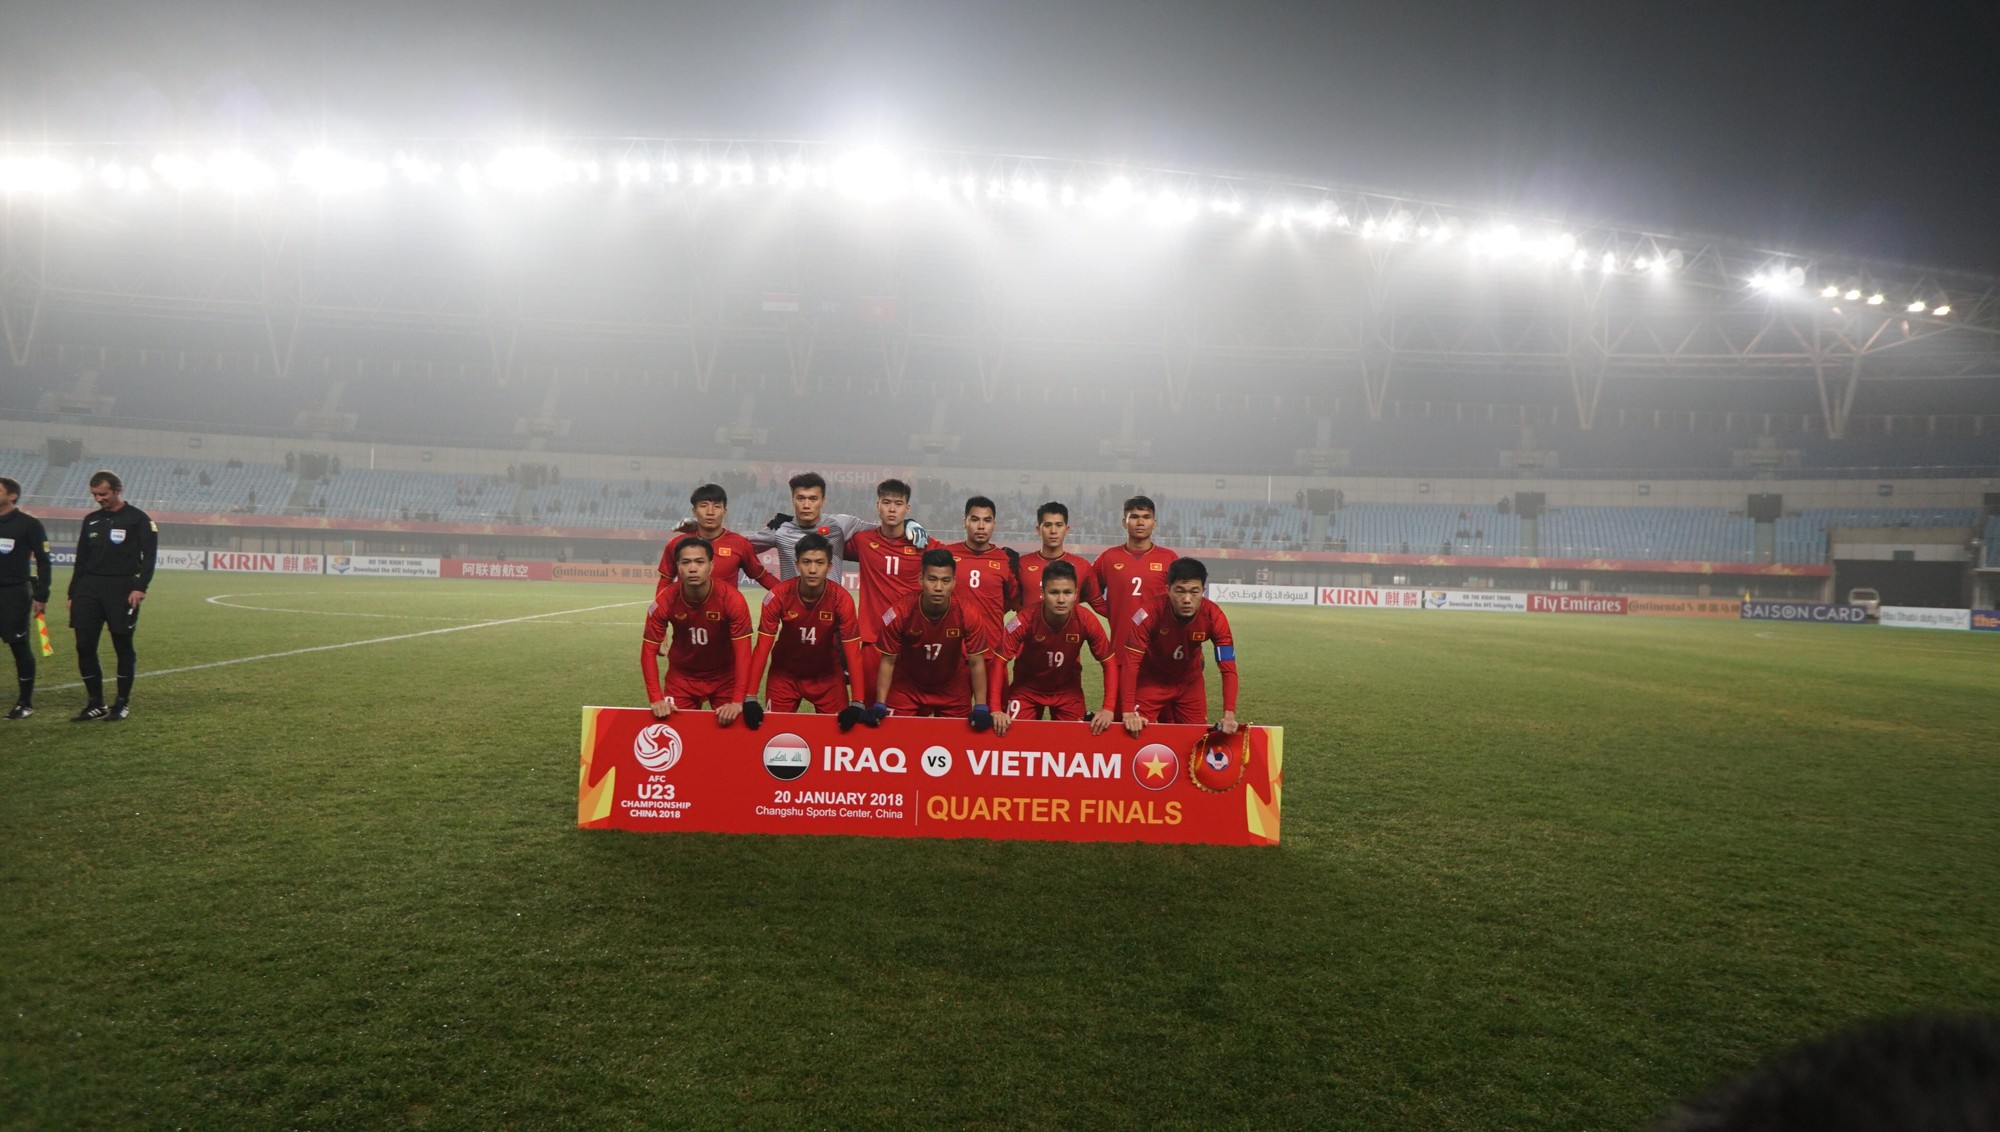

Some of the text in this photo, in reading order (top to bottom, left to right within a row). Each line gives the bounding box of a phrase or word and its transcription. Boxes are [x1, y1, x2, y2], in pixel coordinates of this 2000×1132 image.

[788, 469, 877, 483] CNGSHU
[167, 555, 186, 564] free
[212, 553, 276, 571] KIRIN
[884, 556, 900, 576] 11
[402, 568, 424, 576] Integrity
[969, 570, 980, 588] 8
[1132, 576, 1142, 596] 2
[1322, 588, 1378, 606] KIRIN
[1533, 595, 1622, 612] Fly Emirates
[1743, 603, 1865, 622] SAISON CARD
[688, 626, 708, 646] 10
[800, 626, 817, 646] 14
[924, 644, 942, 660] 17
[1046, 651, 1065, 668] 19
[1173, 645, 1184, 660] 6
[824, 746, 1122, 779] IRAQ VS VIETNAM
[638, 784, 676, 800] U23
[774, 790, 904, 806] 20 JANUARY 2018
[621, 800, 692, 810] CHAMPIONSHIP
[630, 809, 681, 818] CHINA 2018
[755, 806, 903, 819] Changshu Sports Center, China
[926, 794, 1183, 825] QUARTER FINALS
